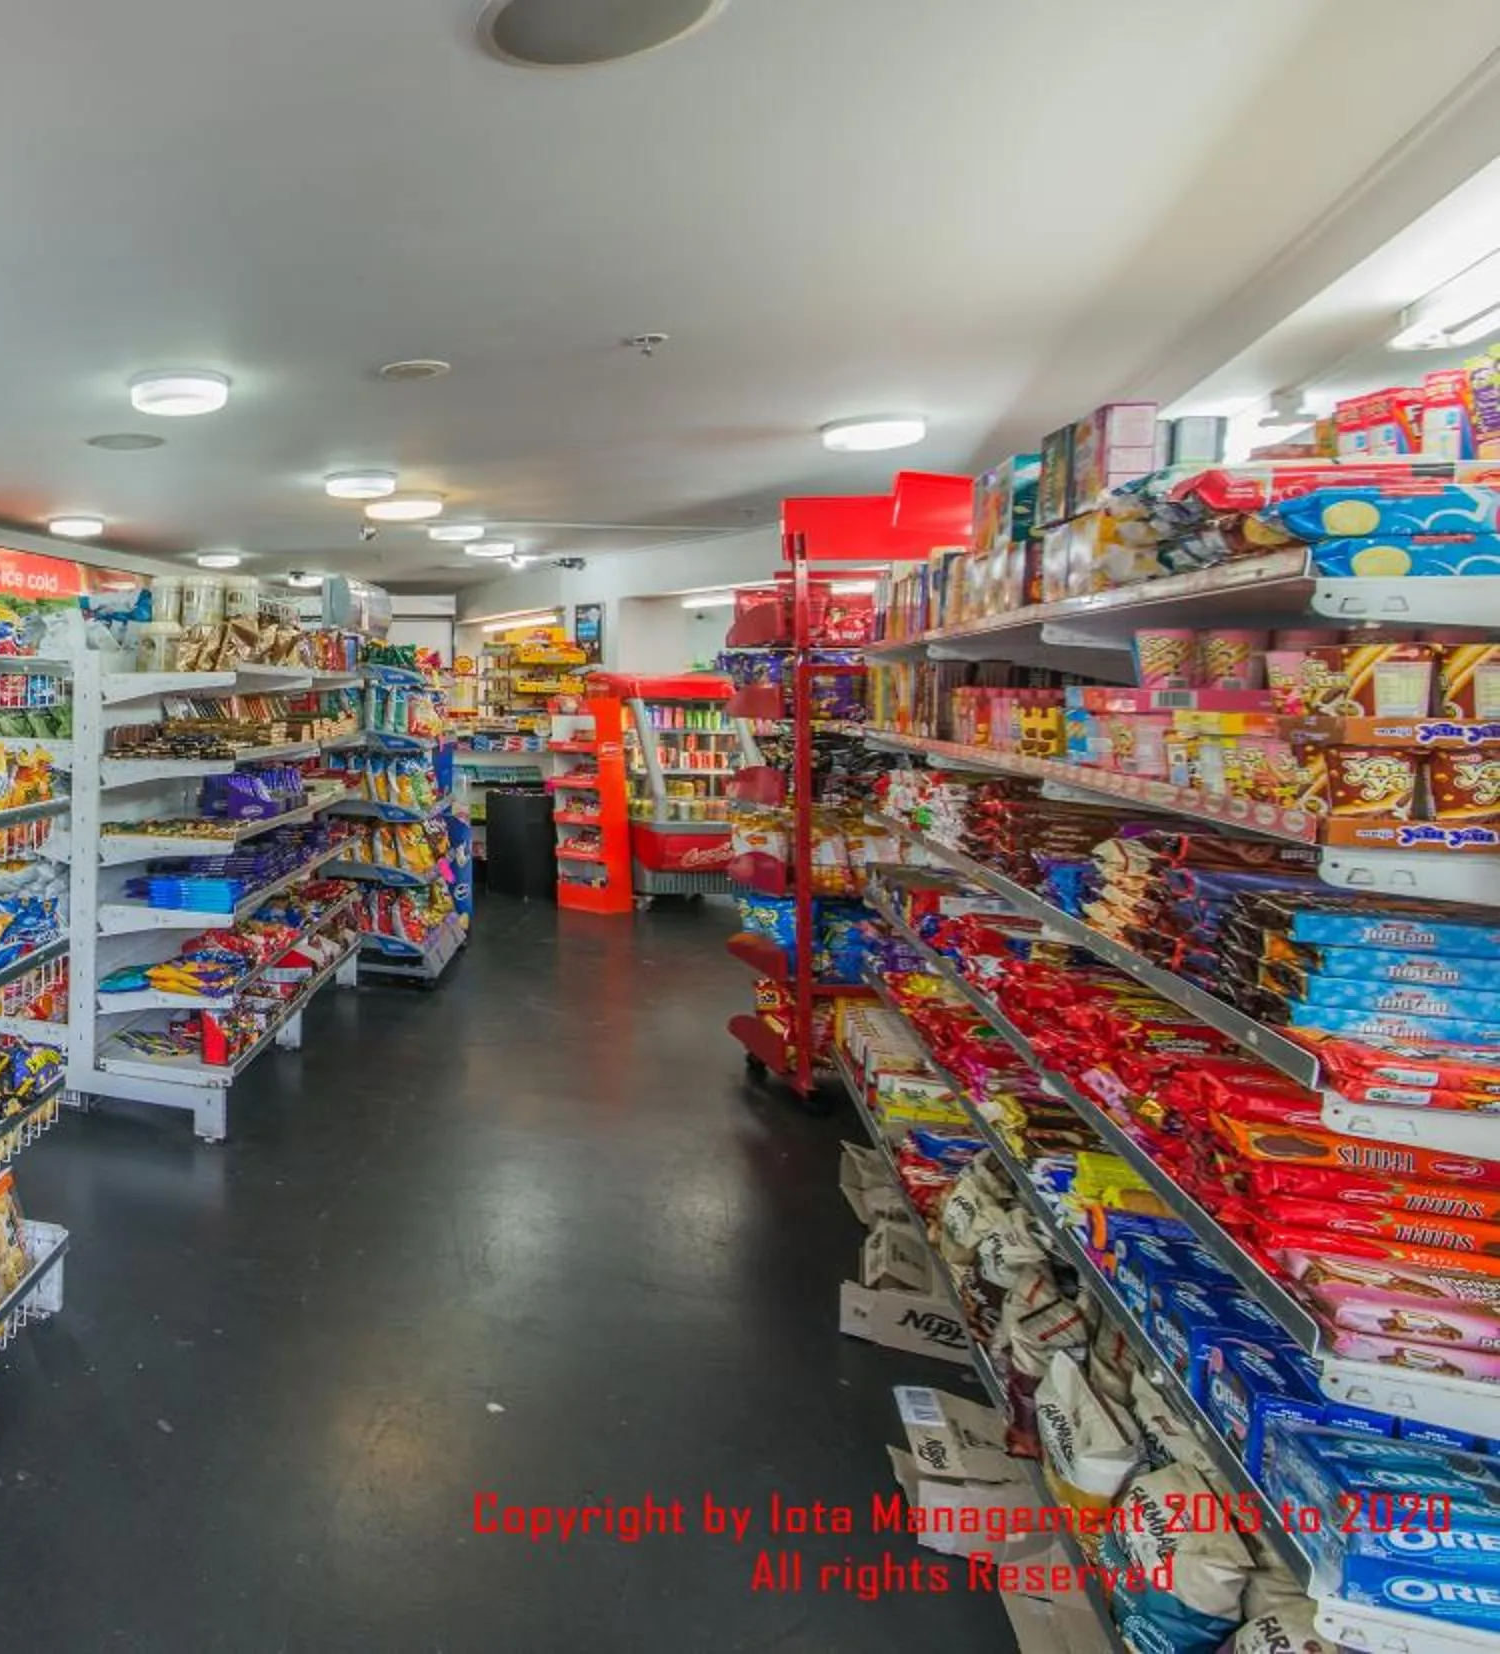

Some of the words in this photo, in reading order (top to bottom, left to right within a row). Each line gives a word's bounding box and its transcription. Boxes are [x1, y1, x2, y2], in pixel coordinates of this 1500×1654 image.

[1, 568, 24, 588] ice
[27, 572, 60, 593] cold
[1389, 1528, 1500, 1552] ORE
[1390, 1576, 1500, 1605] ORE
